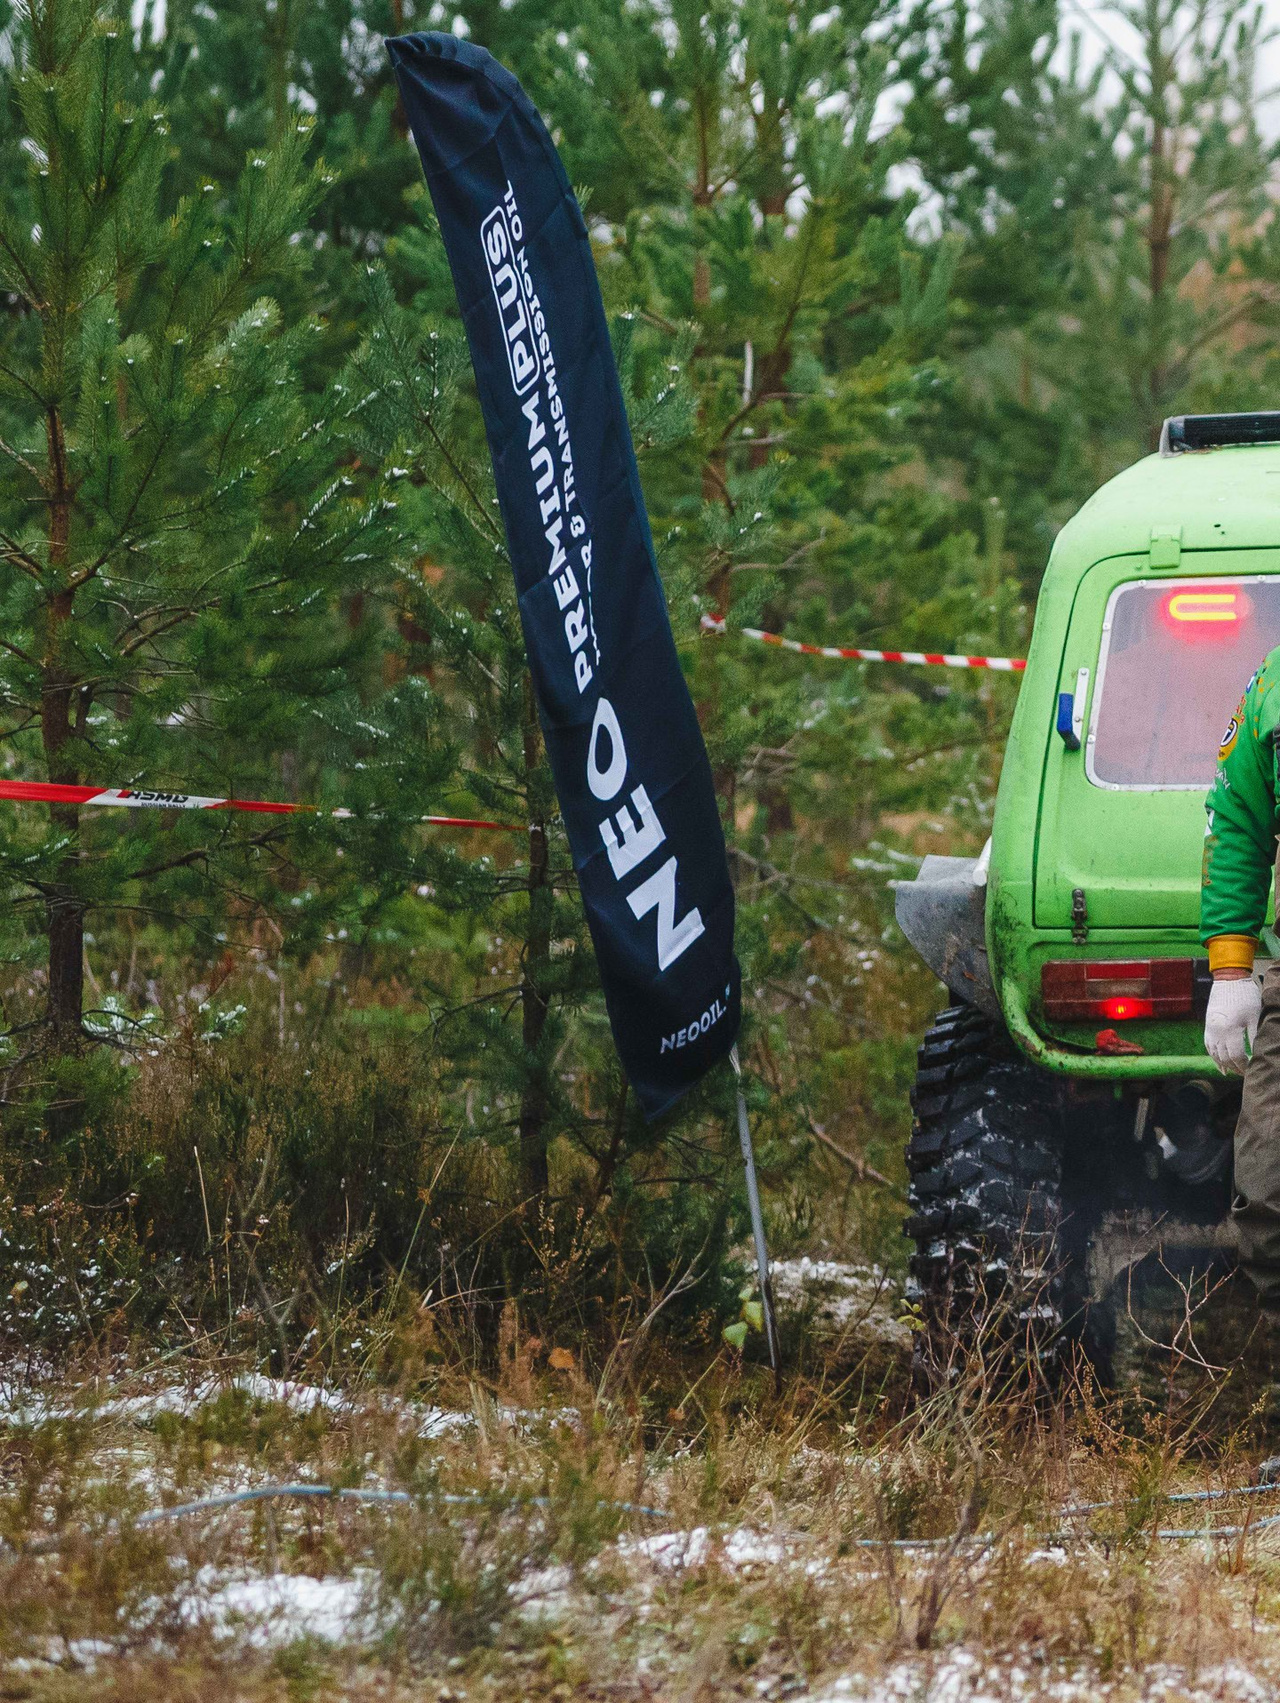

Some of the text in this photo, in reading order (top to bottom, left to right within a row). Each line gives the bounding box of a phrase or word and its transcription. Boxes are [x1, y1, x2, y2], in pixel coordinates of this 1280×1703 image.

[486, 221, 593, 694] PREMIUM PLUS
[503, 179, 587, 538] & TRANSMISSION OIL
[586, 697, 706, 971] NEO
